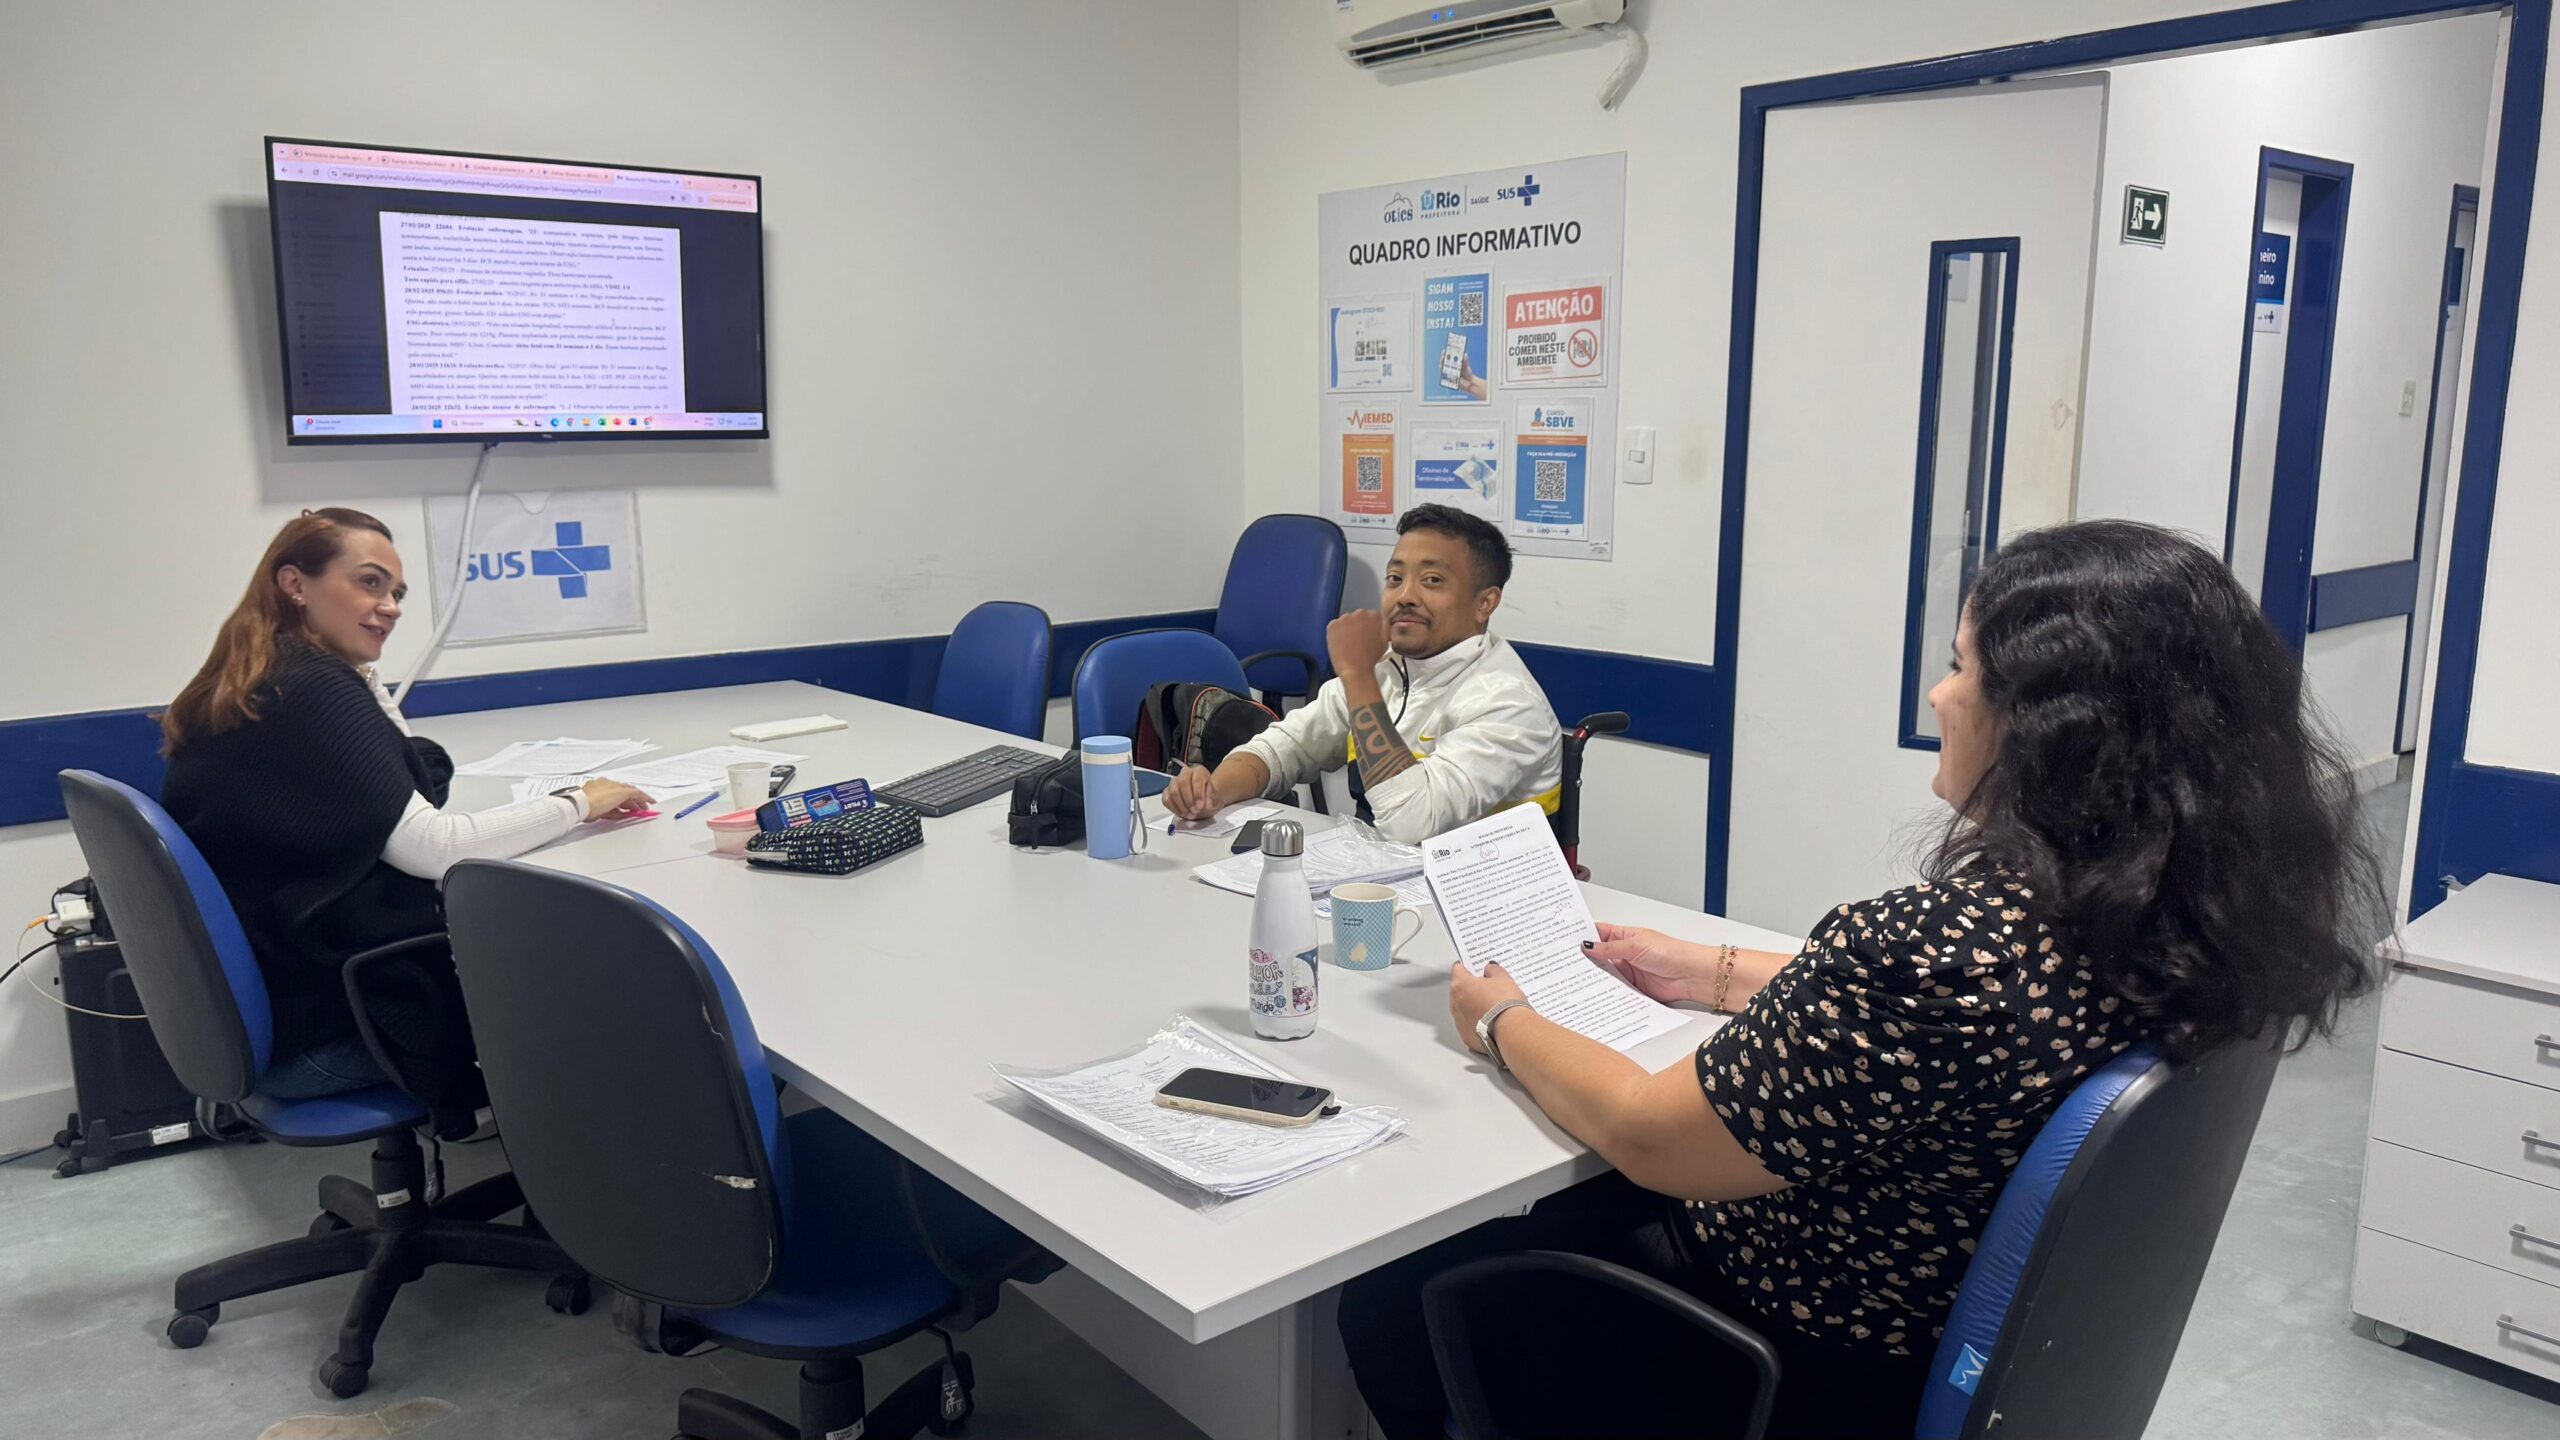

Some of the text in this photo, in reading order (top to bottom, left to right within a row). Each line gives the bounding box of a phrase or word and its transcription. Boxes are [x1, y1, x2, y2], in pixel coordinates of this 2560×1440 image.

[1436, 190, 1460, 209] Rio
[1496, 187, 1516, 200] SUS
[1349, 220, 1582, 266] QUADRO INFORMATIVO
[1428, 283, 1454, 295] SIGAM
[1427, 300, 1454, 312] NOSSO
[1515, 292, 1594, 323] ATENÇÃO
[1518, 332, 1556, 345] PROIBIDO
[1509, 343, 1566, 356] COMER NESTE
[1517, 355, 1557, 367] AMBIENTE
[1546, 417, 1574, 428] SBVE
[466, 551, 525, 582] SUS
[843, 801, 861, 810] PILOT
[1438, 848, 1450, 857] Rio
